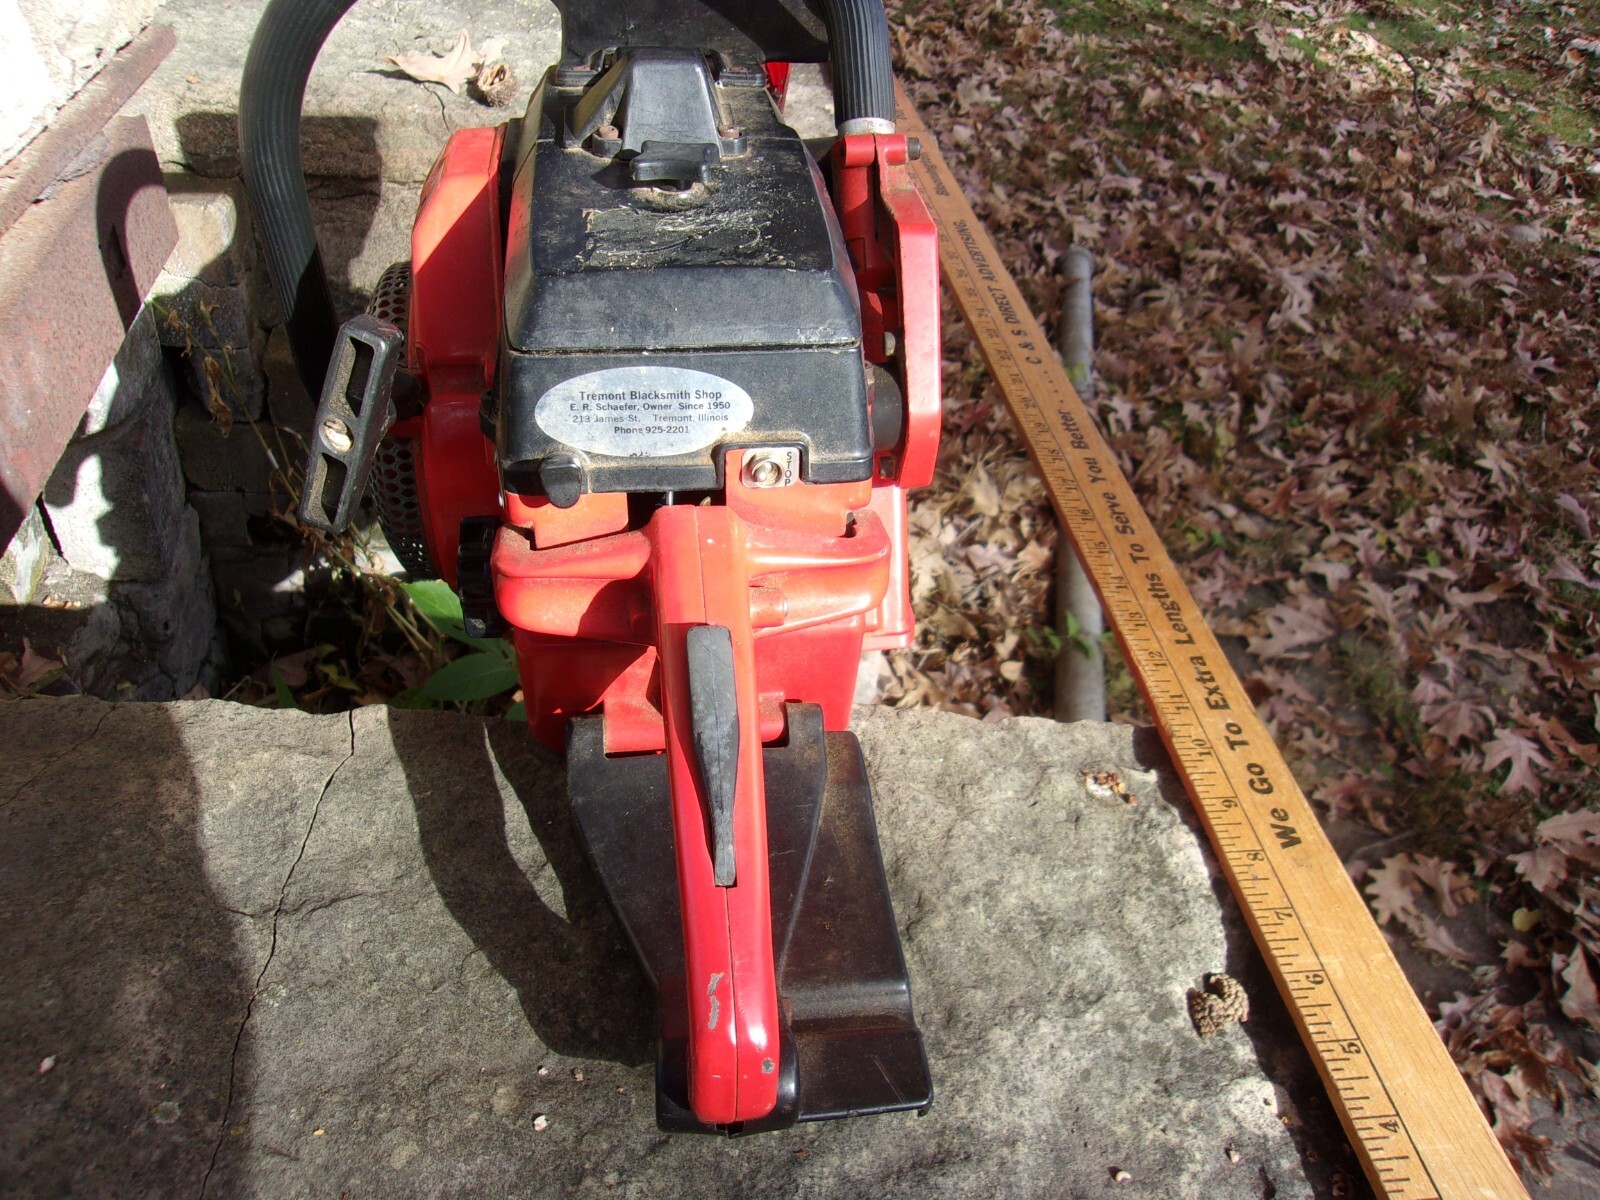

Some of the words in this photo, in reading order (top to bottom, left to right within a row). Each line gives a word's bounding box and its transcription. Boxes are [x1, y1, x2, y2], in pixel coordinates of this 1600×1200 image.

[953, 220, 998, 282] ADVERTISING,
[987, 286, 1021, 324] DIRECT
[1018, 342, 1035, 351] &
[1025, 356, 1042, 365] C
[578, 390, 626, 401] Tremont
[630, 390, 691, 401] Blacksmith
[695, 389, 722, 401] Shop
[570, 403, 579, 412] E.
[582, 403, 593, 411] R.
[596, 402, 640, 412] Schaefer,
[642, 402, 673, 411] Owner
[679, 402, 704, 410] Since
[707, 401, 731, 410] 1950
[572, 414, 591, 423] 213
[594, 414, 625, 423] James
[628, 414, 641, 423] St.
[653, 413, 696, 423] Tremont,
[698, 413, 729, 422] Illinois
[614, 426, 643, 434] Phone
[645, 425, 690, 434] 925-2201
[1058, 409, 1089, 450] Better
[784, 451, 793, 487] STOP
[1084, 457, 1107, 483] You
[1062, 478, 1079, 490] 17
[1078, 509, 1095, 521] 16
[1103, 492, 1135, 535] Serve
[1094, 541, 1110, 554] 15
[1129, 544, 1150, 564] To
[1110, 576, 1129, 590] 14
[1146, 573, 1196, 645] Lengths
[1128, 612, 1147, 628] 13
[1149, 651, 1168, 668] 12
[1190, 655, 1231, 711] Extra
[1169, 694, 1190, 712] 11
[1225, 722, 1249, 751] To
[1191, 738, 1214, 758] 10
[1247, 763, 1274, 795] Go
[1222, 799, 1238, 809] 9
[1270, 807, 1302, 849] We
[1247, 852, 1265, 862] 8
[1275, 910, 1294, 921] 7
[1306, 973, 1325, 985] 6
[1340, 1041, 1362, 1055] 5
[1379, 1120, 1399, 1133] 4
